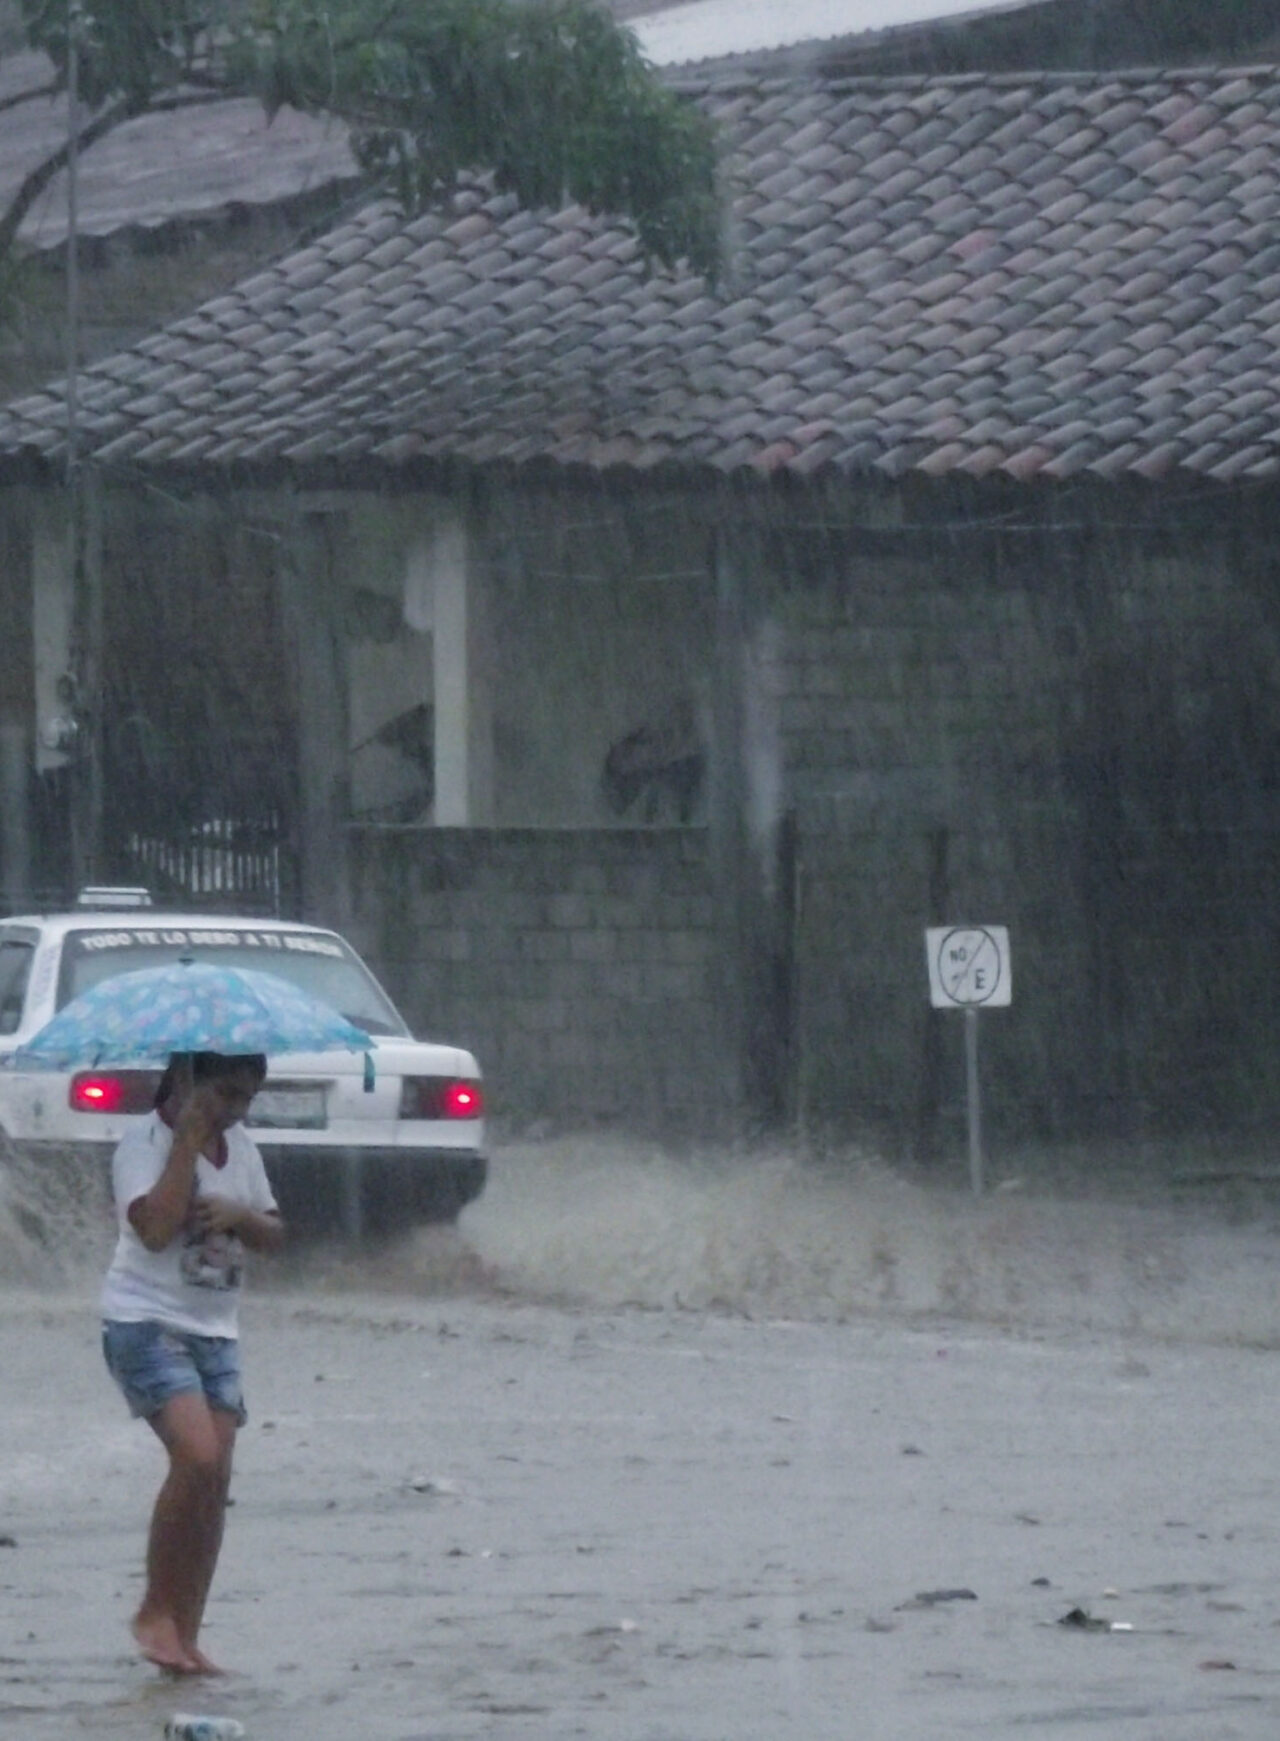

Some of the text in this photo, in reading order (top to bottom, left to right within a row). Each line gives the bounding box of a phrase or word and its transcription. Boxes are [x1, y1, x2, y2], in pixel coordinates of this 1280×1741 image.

[81, 932, 130, 950] TODO
[133, 931, 159, 944] TE
[162, 931, 187, 945] LO
[190, 931, 239, 945] DEBO
[245, 932, 260, 945] A
[263, 933, 282, 948] TI
[949, 947, 967, 963] NO
[974, 968, 986, 990] E
